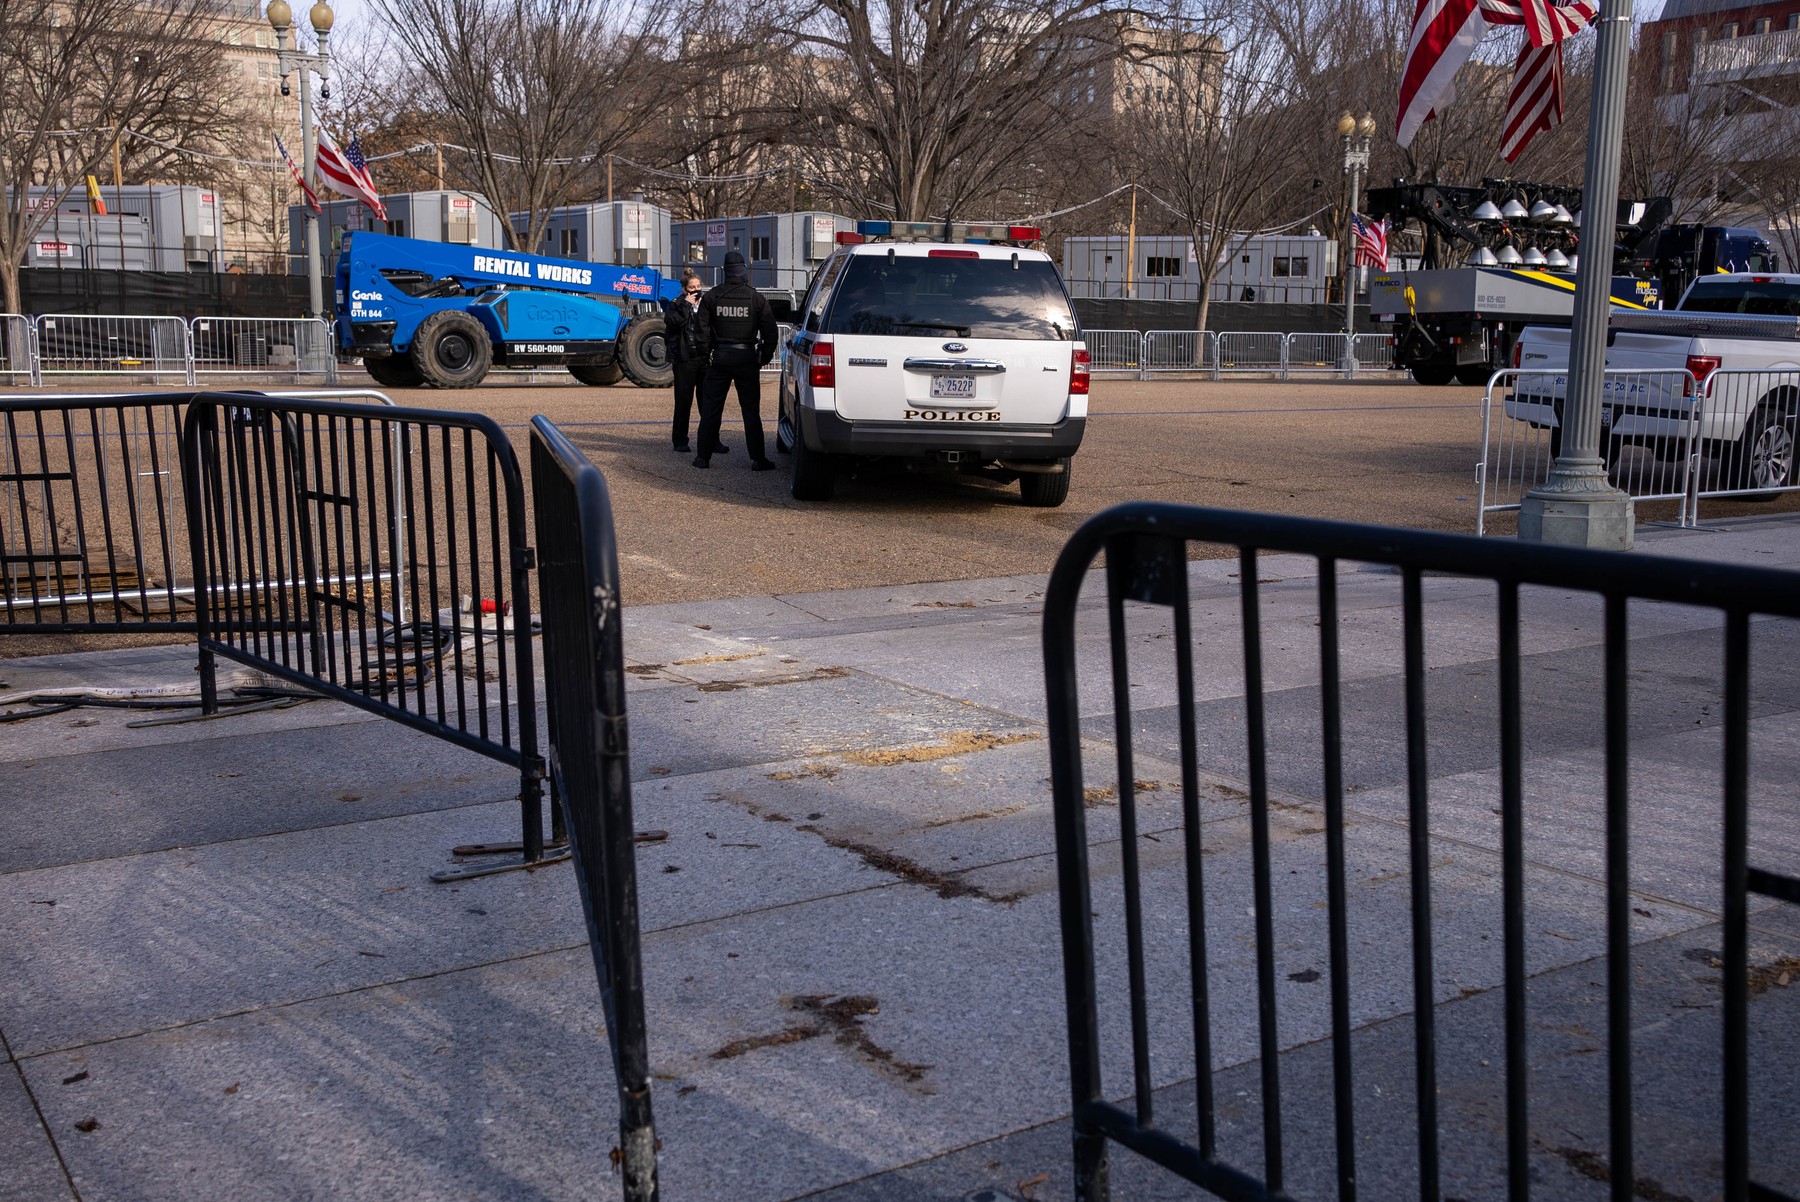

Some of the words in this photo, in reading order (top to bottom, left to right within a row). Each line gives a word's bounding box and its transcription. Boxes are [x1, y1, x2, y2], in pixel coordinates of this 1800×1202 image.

[708, 225, 724, 235] ALLIED
[473, 255, 532, 278] RENTAL
[537, 263, 592, 285] WORKS
[352, 290, 383, 301] Genie
[351, 309, 367, 318] GTH
[368, 309, 382, 318] 844
[716, 305, 749, 318] POLICE
[514, 344, 526, 353] RW
[947, 380, 972, 392] 2522P
[903, 409, 1001, 422] POLICE
